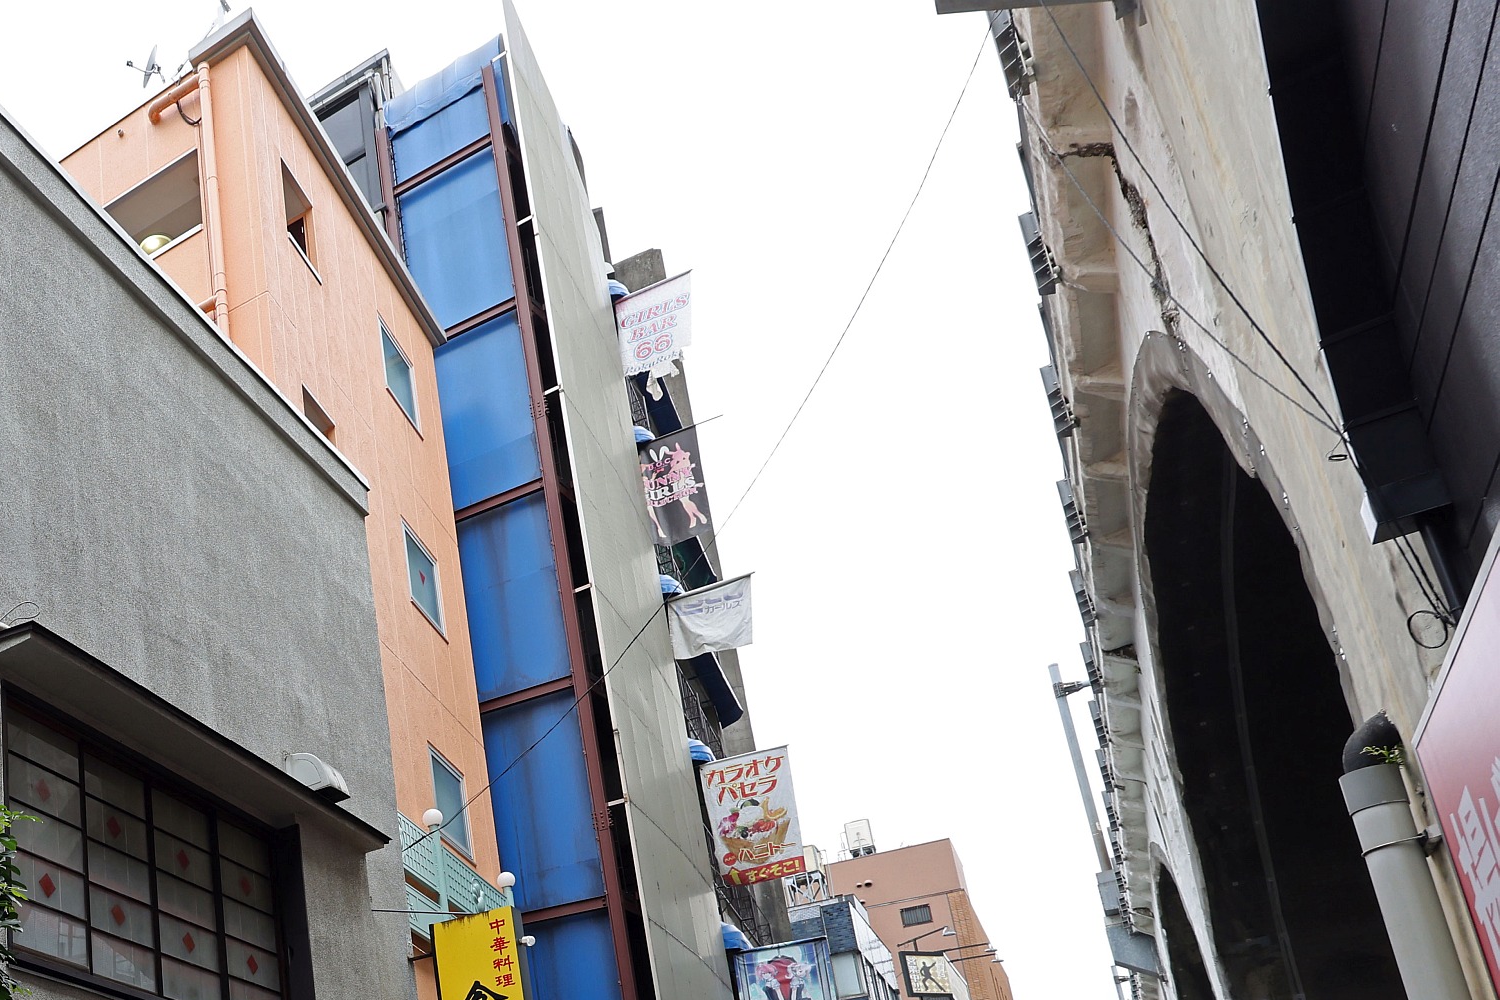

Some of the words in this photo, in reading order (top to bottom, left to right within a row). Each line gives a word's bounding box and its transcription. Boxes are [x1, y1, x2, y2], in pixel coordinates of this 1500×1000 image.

[620, 293, 690, 330] GIRLS
[627, 314, 678, 343] BAR
[634, 332, 673, 361] 66
[704, 600, 743, 614] ガールズ
[705, 755, 785, 788] カラオケ
[717, 774, 778, 806] パセラ
[738, 842, 797, 863] ハニトー
[745, 858, 801, 882] すぐそこ!
[489, 919, 516, 988] 中華料理
